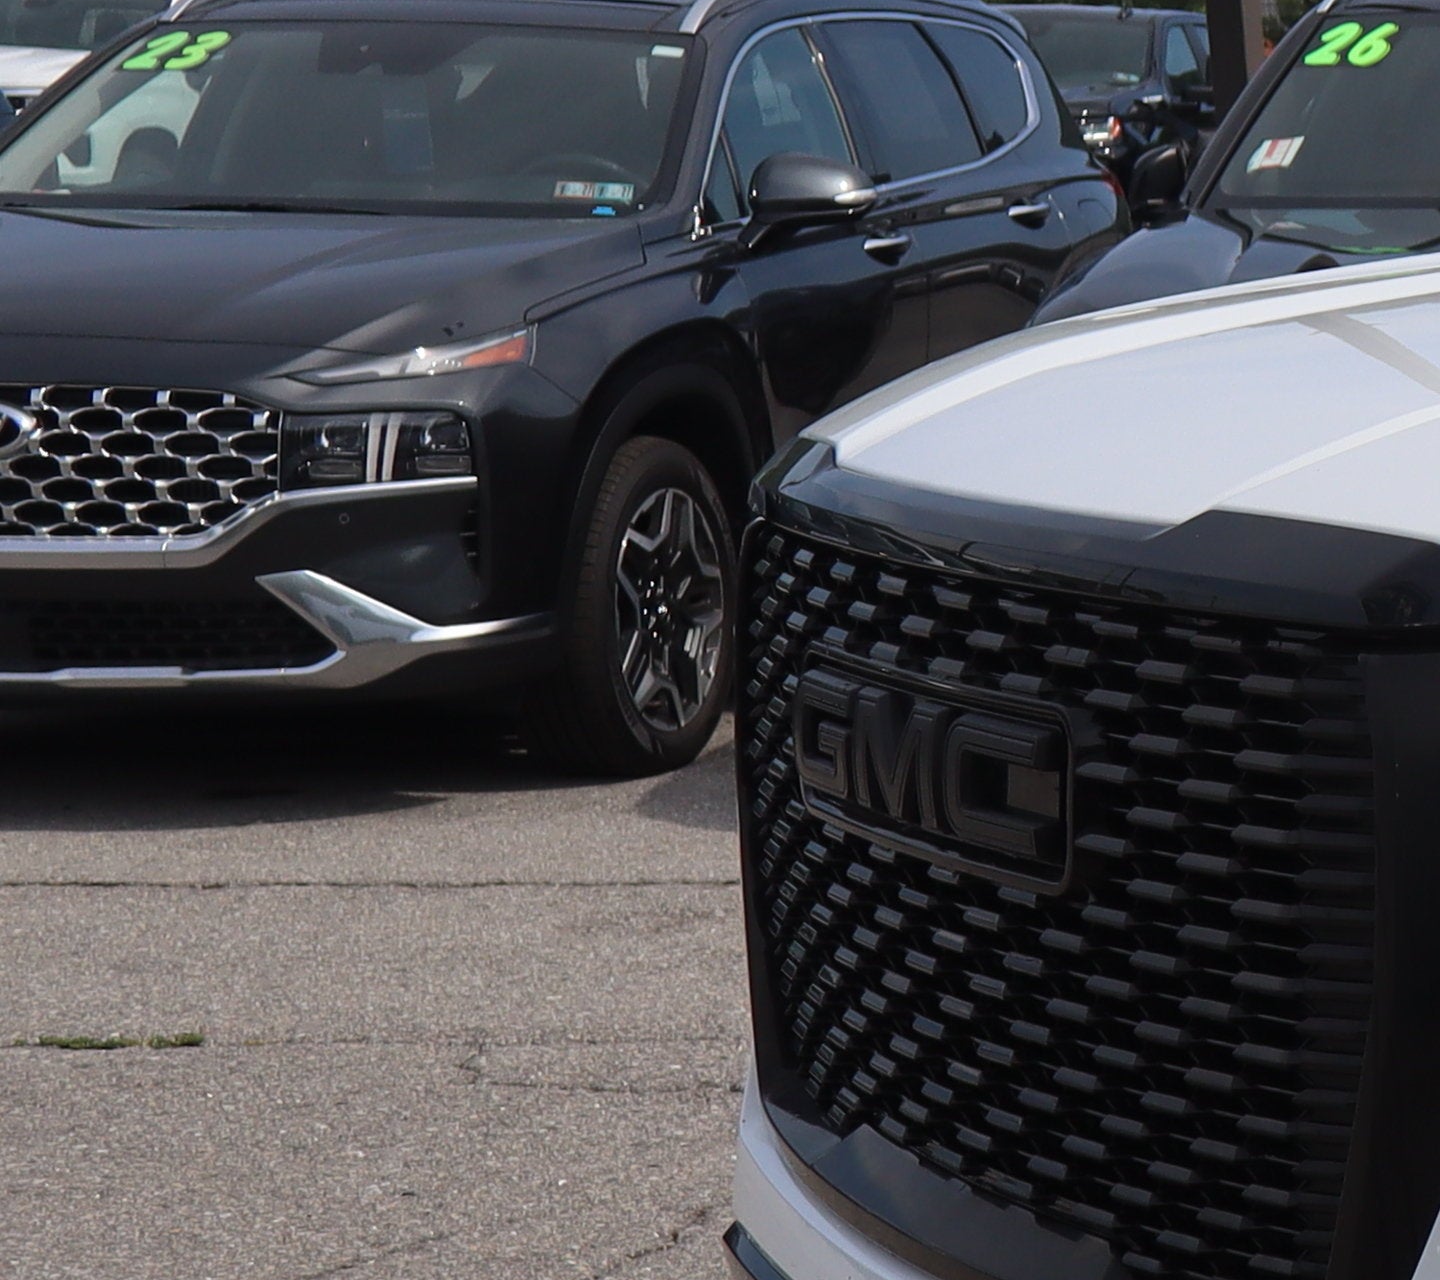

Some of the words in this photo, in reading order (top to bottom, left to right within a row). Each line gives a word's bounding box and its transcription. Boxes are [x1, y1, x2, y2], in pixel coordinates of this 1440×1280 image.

[122, 30, 232, 70] 23
[1303, 21, 1399, 67] 26
[794, 669, 1064, 861] GMC
